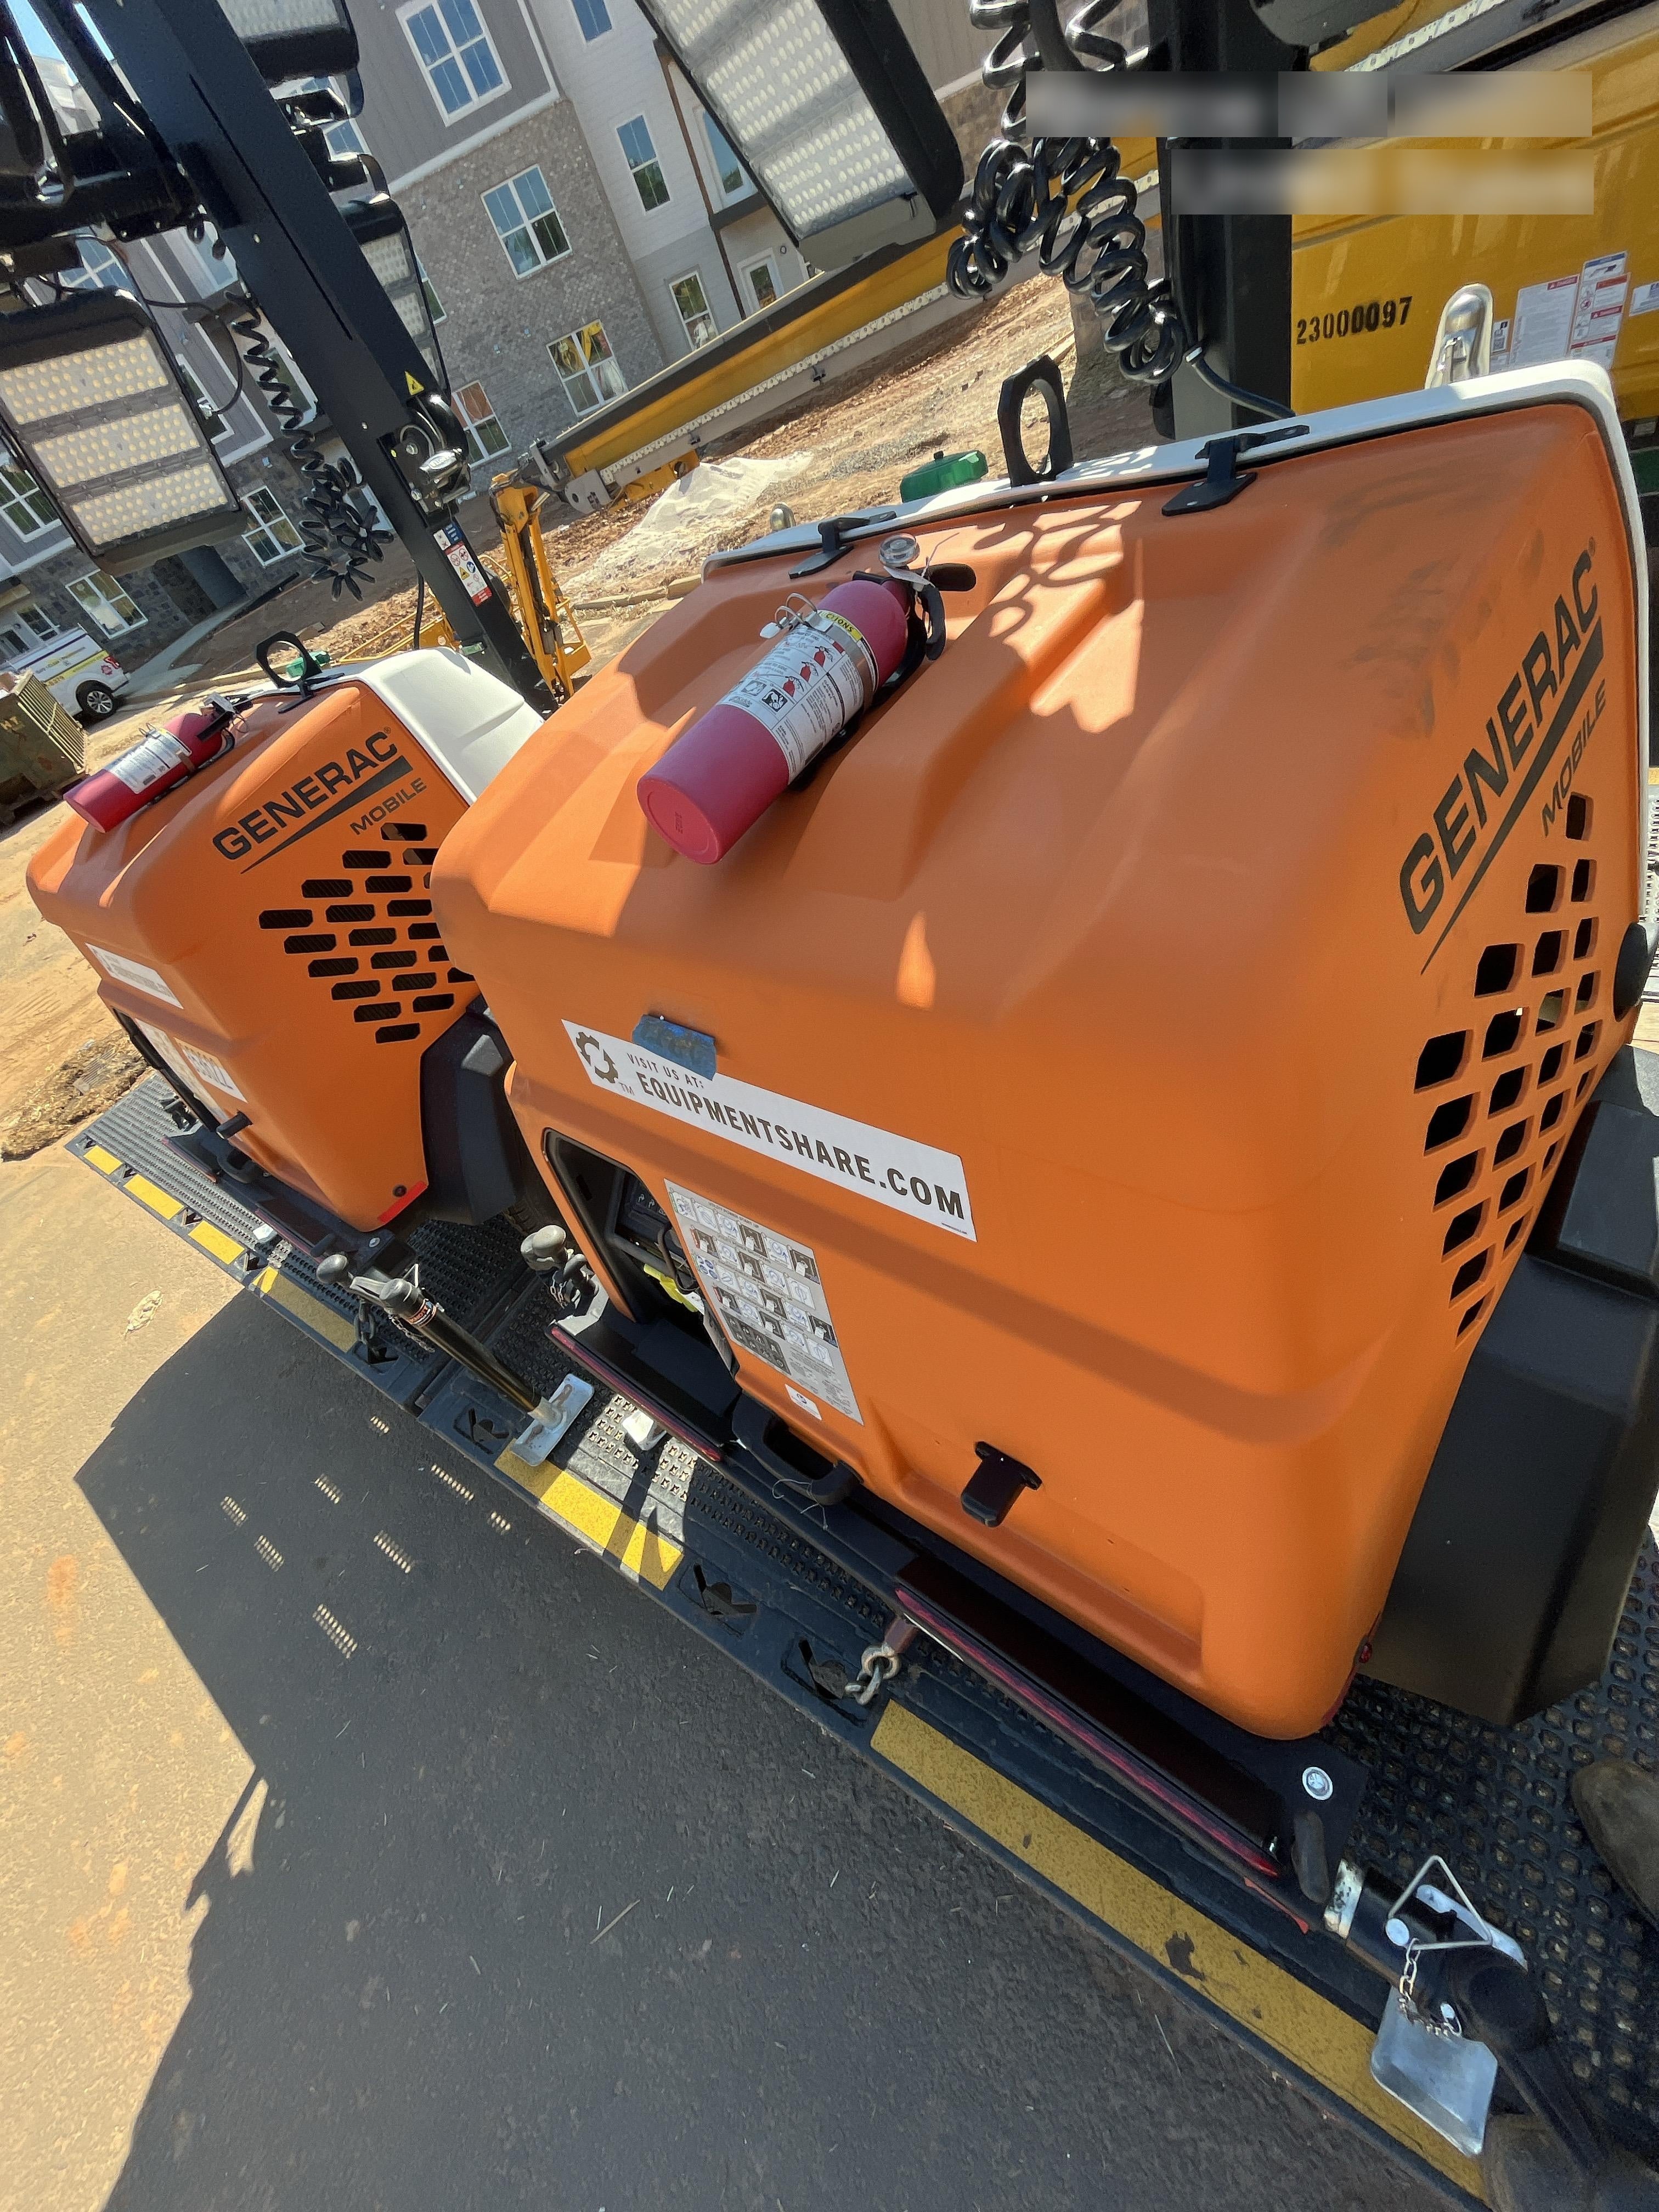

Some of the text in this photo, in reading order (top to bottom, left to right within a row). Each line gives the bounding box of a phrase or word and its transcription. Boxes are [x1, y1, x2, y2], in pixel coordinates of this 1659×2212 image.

[1296, 296, 1413, 345] 23000097
[212, 730, 398, 860] GENERAC
[349, 777, 427, 836] MOBILE
[1399, 549, 1599, 935] GENERAC
[1542, 678, 1607, 838] MOBILE
[627, 1053, 704, 1089] VISIT US AT:
[635, 1071, 964, 1220] EQUIPMENTSHARE.COM
